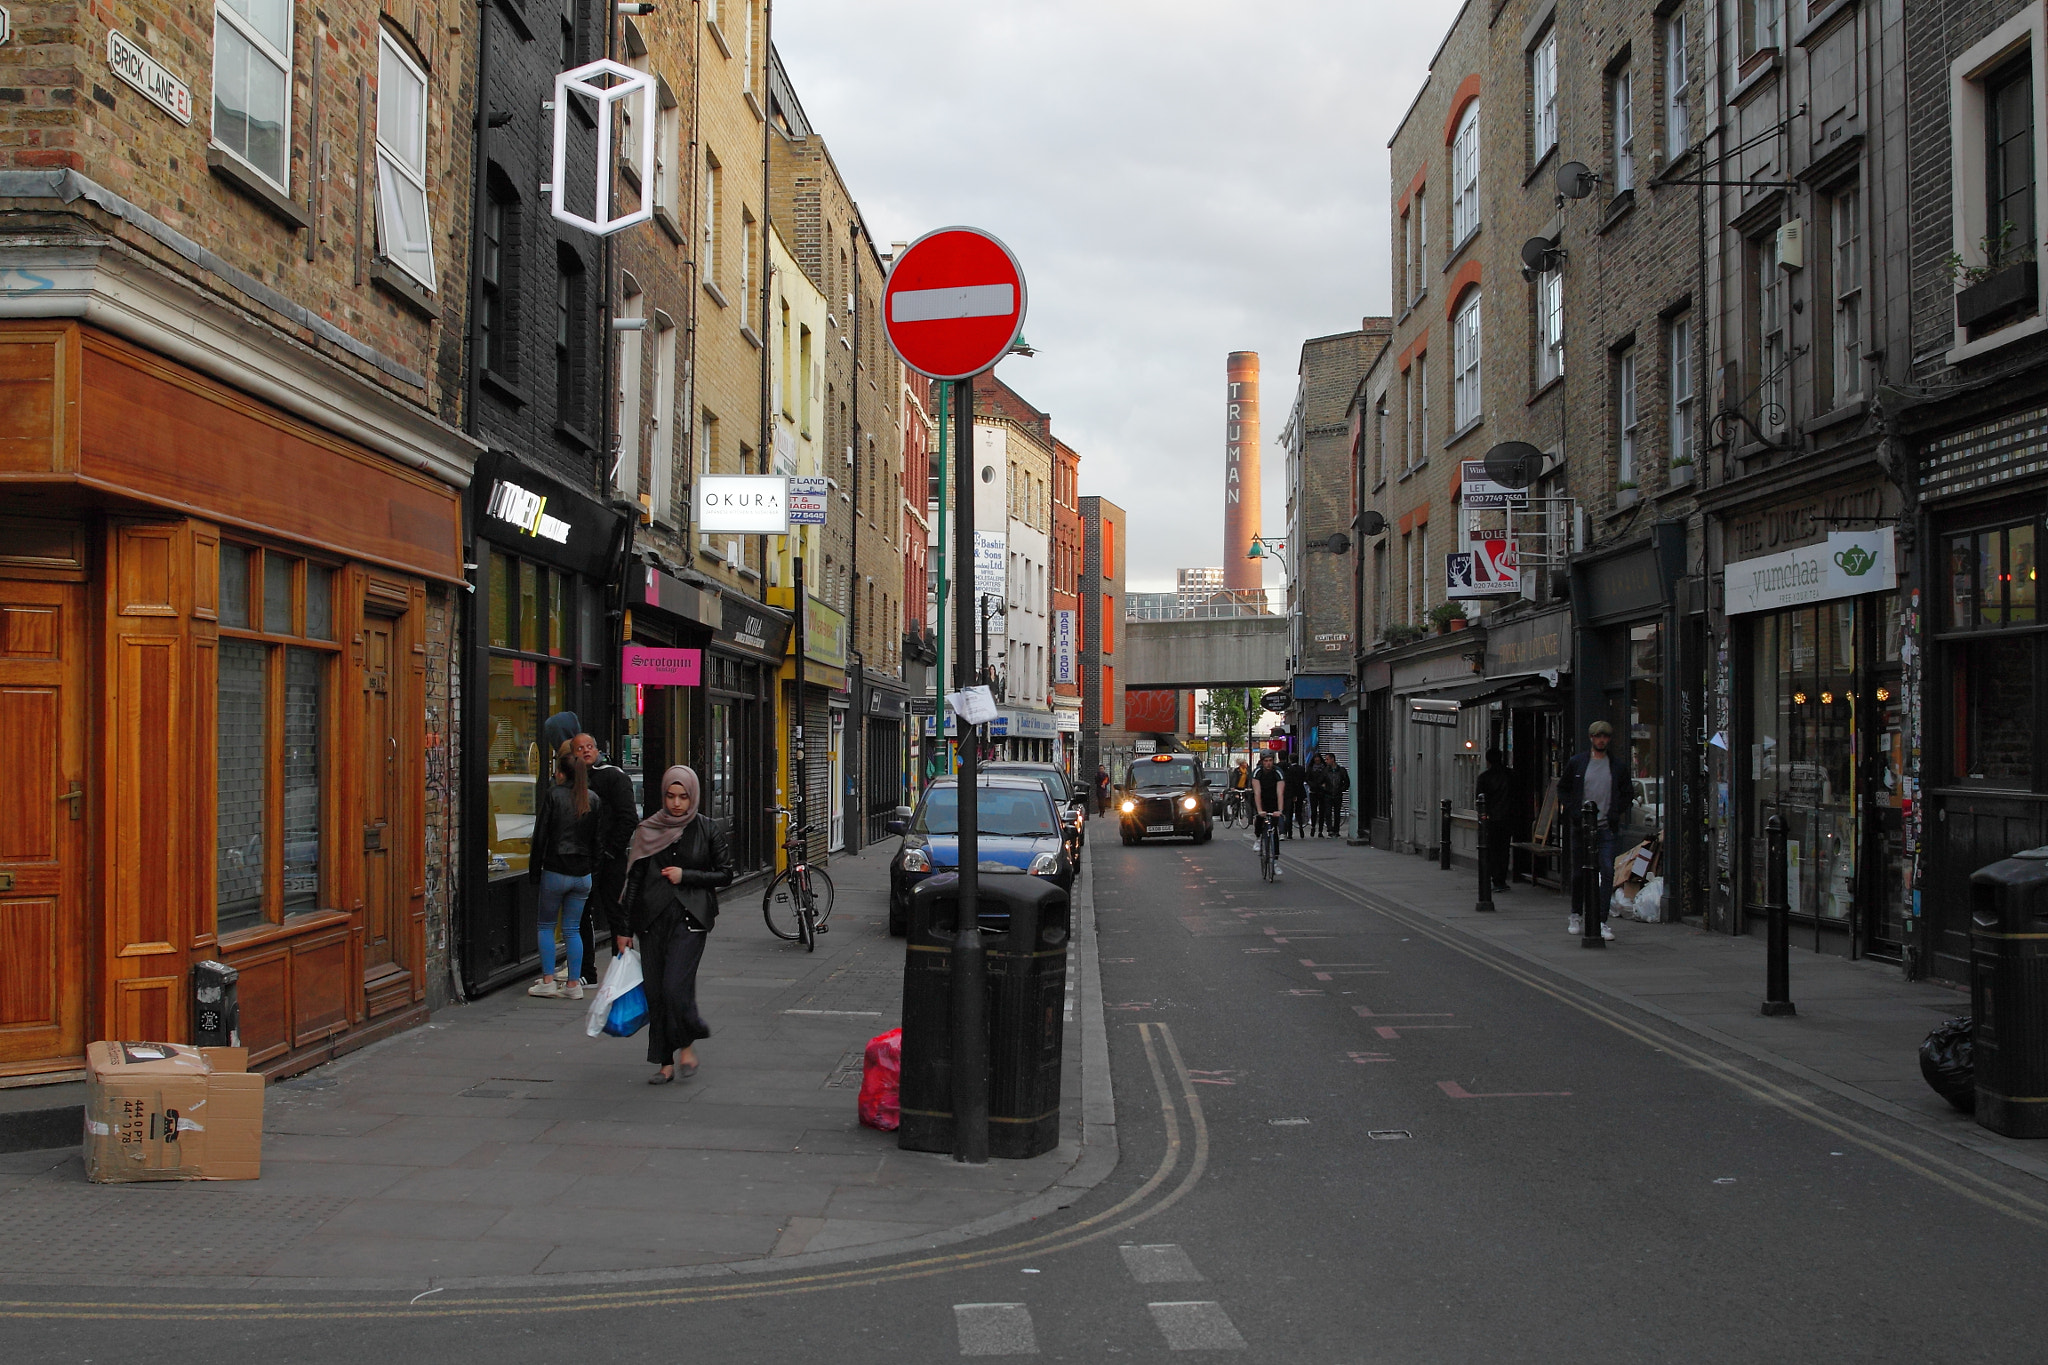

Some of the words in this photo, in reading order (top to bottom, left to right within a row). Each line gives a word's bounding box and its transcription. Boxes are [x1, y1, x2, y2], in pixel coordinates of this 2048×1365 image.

[114, 39, 144, 84] BRICK
[147, 66, 175, 107] LANE
[1228, 382, 1241, 504] TRUMAN
[1469, 484, 1486, 493] LET
[705, 493, 778, 507] OKURA
[1470, 495, 1484, 503] 020
[1485, 494, 1503, 502] 7749
[981, 538, 1005, 550] Bashir
[1480, 530, 1492, 540] TO
[974, 549, 980, 558] &
[984, 549, 1002, 559] Sons
[1750, 553, 1819, 607] yumchaa
[1060, 611, 1069, 647] BASHIR
[1529, 633, 1558, 661] LOUNGE
[631, 655, 691, 668] Serotonin
[1060, 655, 1069, 679] SONS
[123, 1101, 133, 1119] 44
[133, 1099, 145, 1118] 444
